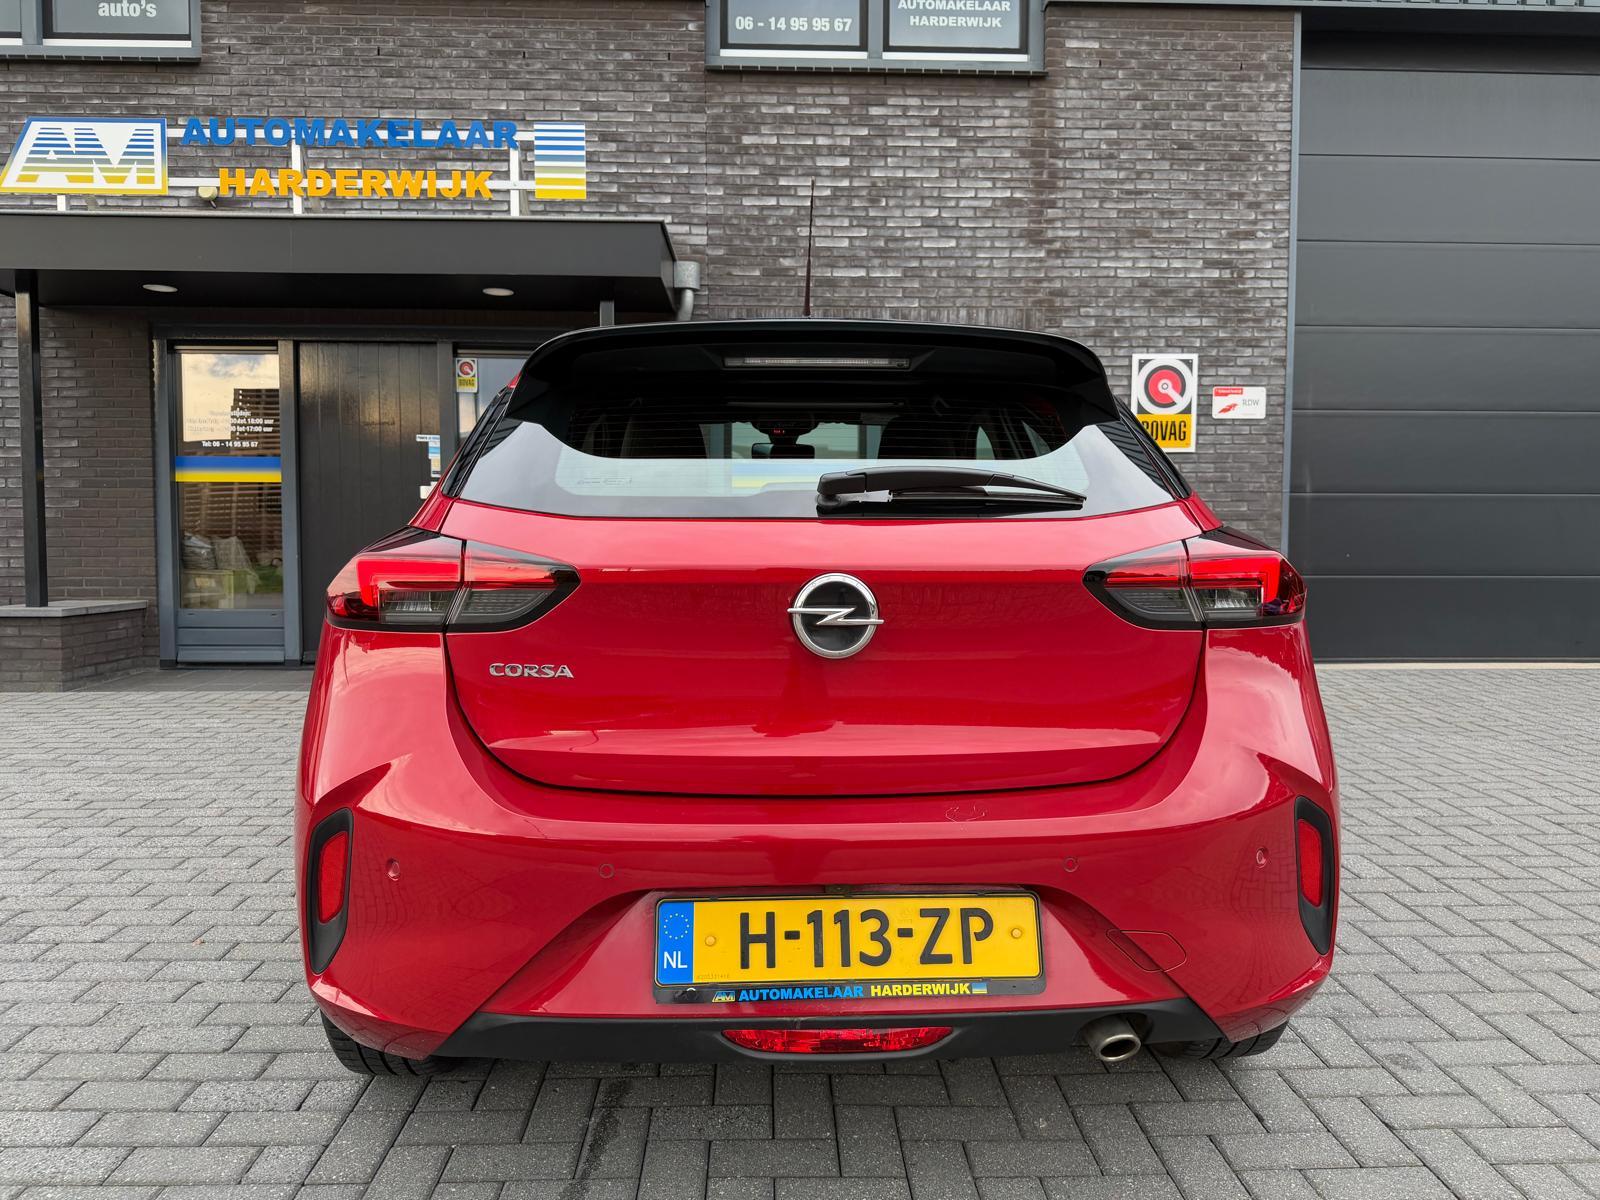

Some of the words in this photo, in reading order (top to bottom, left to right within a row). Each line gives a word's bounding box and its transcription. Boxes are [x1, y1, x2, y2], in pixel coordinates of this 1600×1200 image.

[98, 0, 157, 17] auto's
[897, 0, 1011, 11] AUTOMAKELAAR
[735, 16, 754, 30] 06
[768, 16, 786, 31] 14
[790, 17, 808, 31] 95
[812, 17, 830, 32] 95
[834, 17, 853, 32] 67
[909, 15, 1002, 28] HARDERWIJK
[180, 116, 520, 150] AUTOMAKELAAR
[218, 167, 493, 199] HARDERWIJK
[489, 662, 575, 678] CORSA
[739, 907, 994, 969] H-113-ZP
[663, 951, 688, 969] NL
[738, 985, 864, 1002] AUTOMAKELAAR
[870, 982, 970, 998] HARDERWIJK
